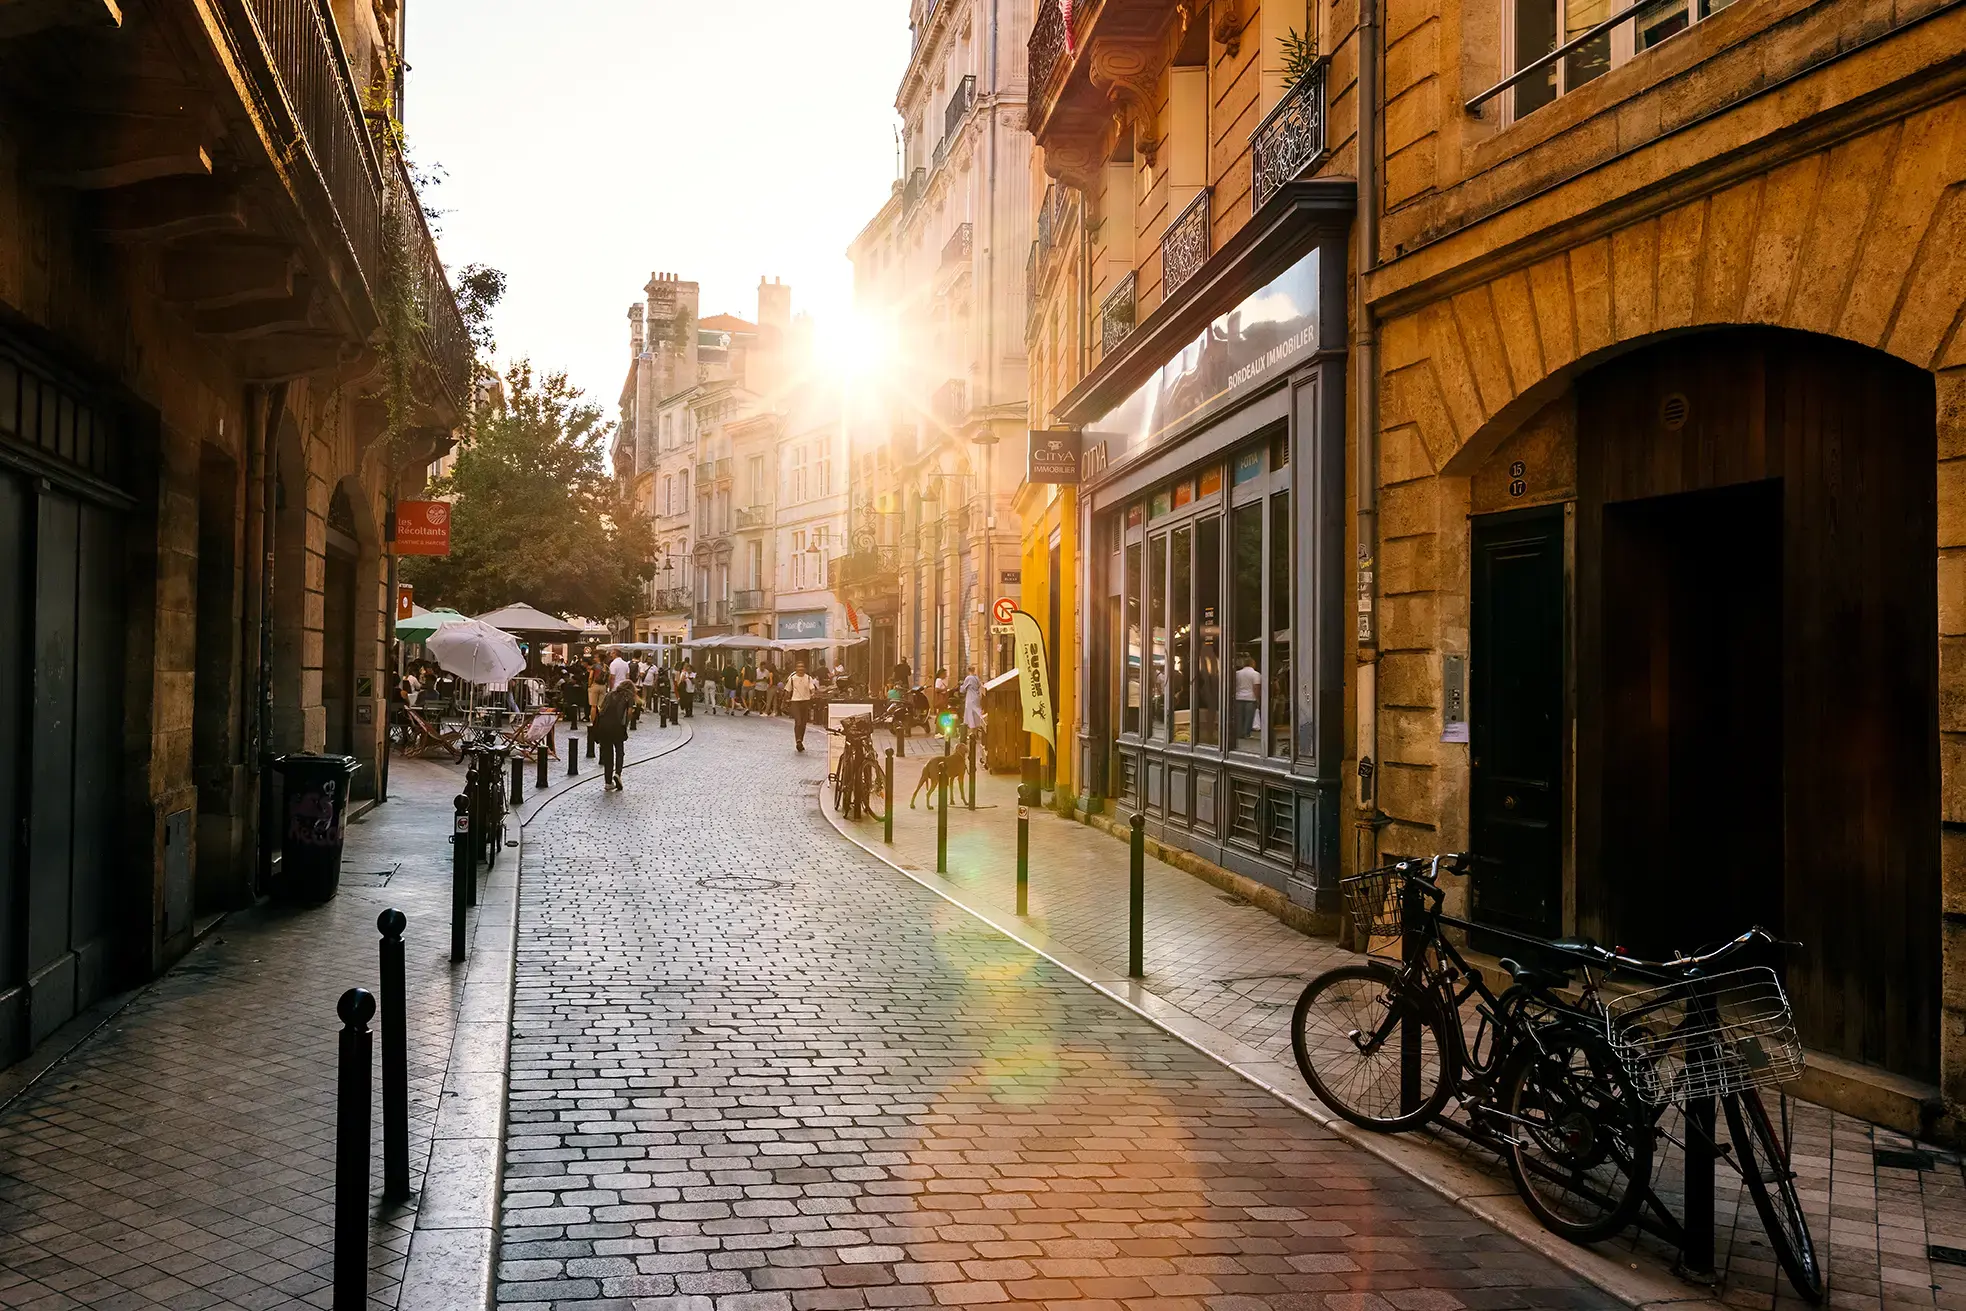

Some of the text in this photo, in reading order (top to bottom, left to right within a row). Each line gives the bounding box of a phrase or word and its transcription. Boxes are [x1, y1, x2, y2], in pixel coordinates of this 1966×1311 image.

[1228, 325, 1314, 390] BORDEAUX IMMOBILIER
[1081, 440, 1107, 482] CITYA
[1513, 464, 1522, 476] 15
[1513, 482, 1523, 493] 17
[398, 525, 447, 536] Récoltants
